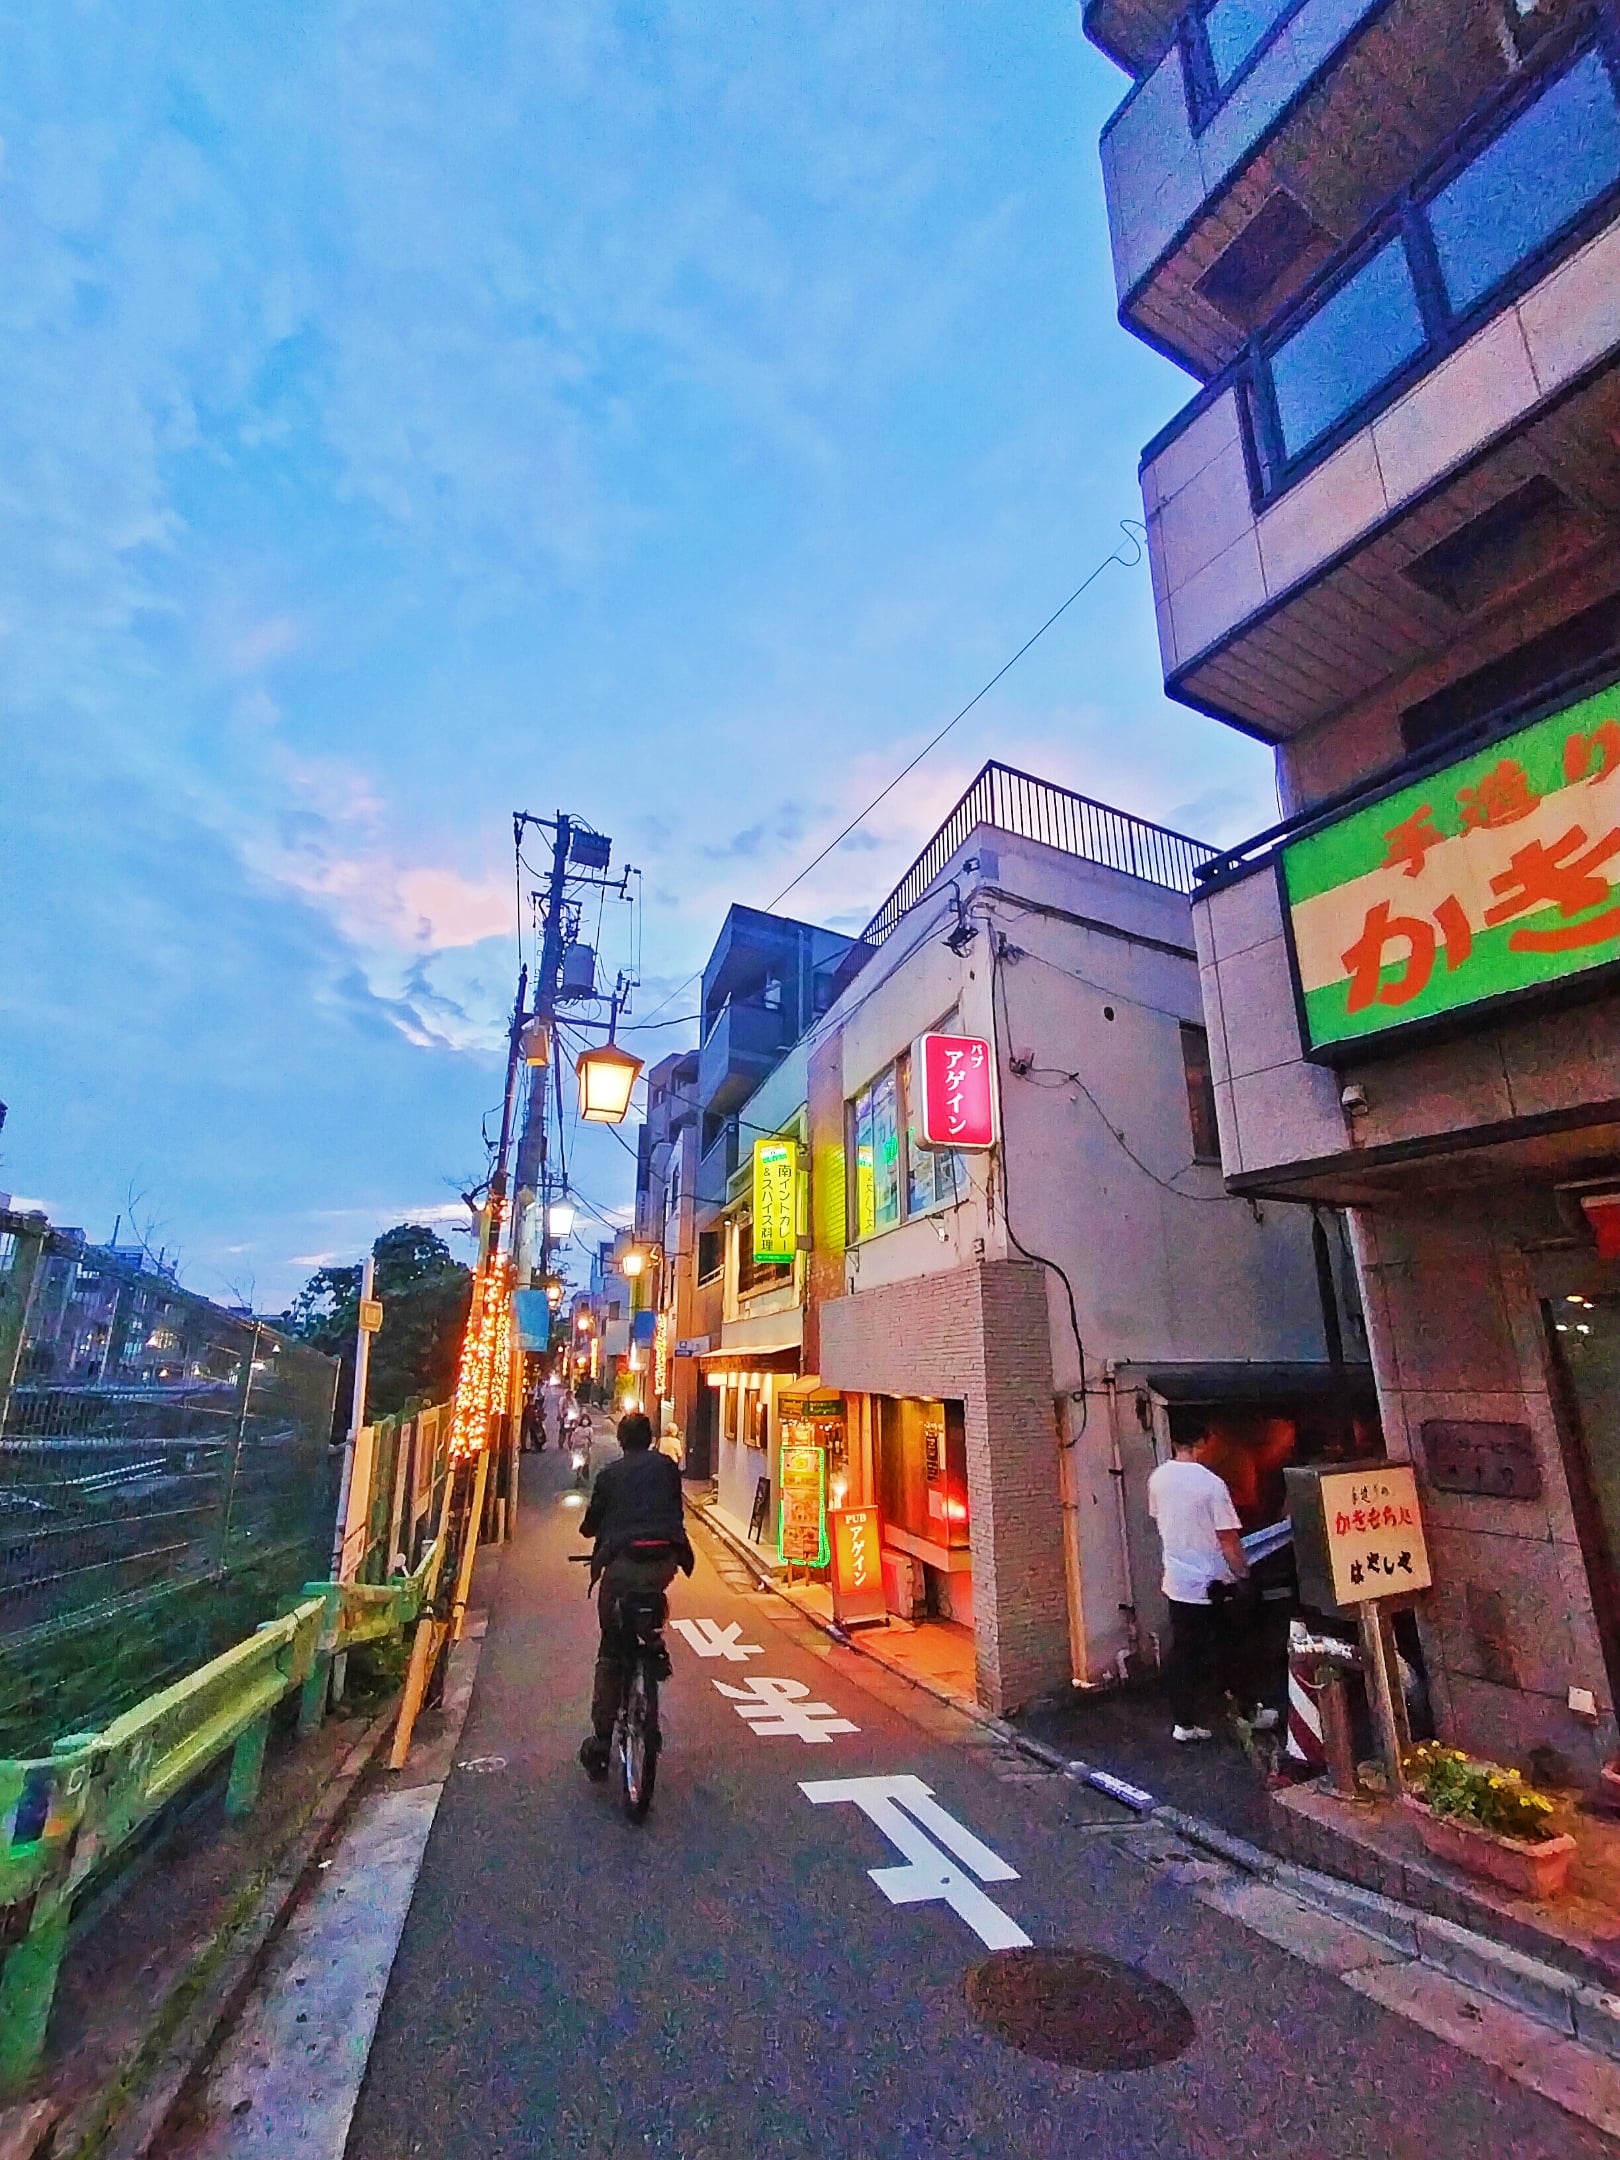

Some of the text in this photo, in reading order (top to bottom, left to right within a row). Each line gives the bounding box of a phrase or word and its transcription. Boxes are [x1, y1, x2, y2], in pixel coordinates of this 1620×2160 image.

[1382, 719, 1620, 877] 手造り
[970, 1044, 985, 1069] パブ
[944, 1049, 967, 1135] アゲイン
[845, 1513, 867, 1525] PUB
[849, 1525, 867, 1587] アゲイン
[1350, 1550, 1414, 1585] はやしや
